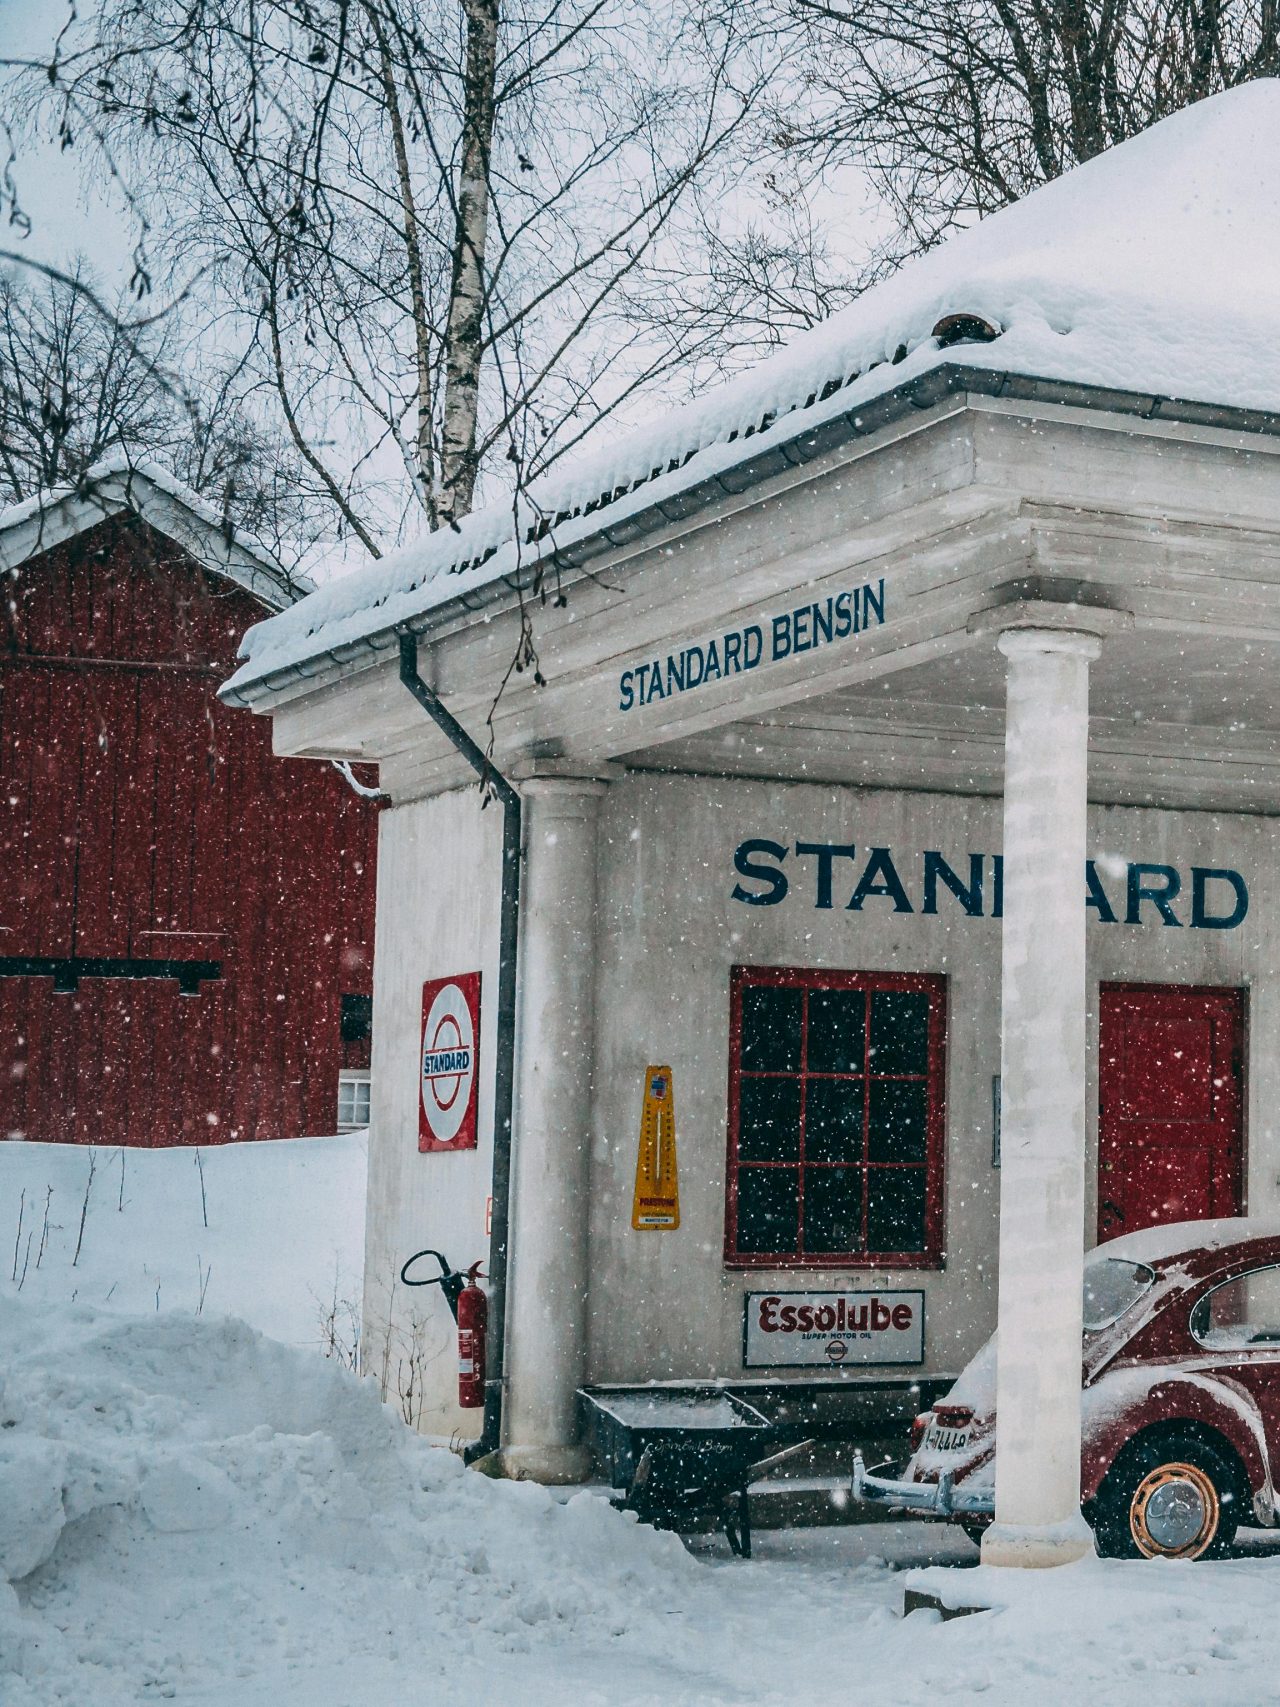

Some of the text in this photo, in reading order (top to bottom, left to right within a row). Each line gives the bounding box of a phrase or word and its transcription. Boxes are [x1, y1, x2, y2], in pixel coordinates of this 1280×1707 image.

[619, 579, 885, 711] STANDARD BENSIN
[731, 838, 1249, 930] STANARD
[424, 1051, 470, 1074] STANDARD
[758, 1296, 913, 1333] Essolube
[830, 1332, 857, 1340] MOTOR
